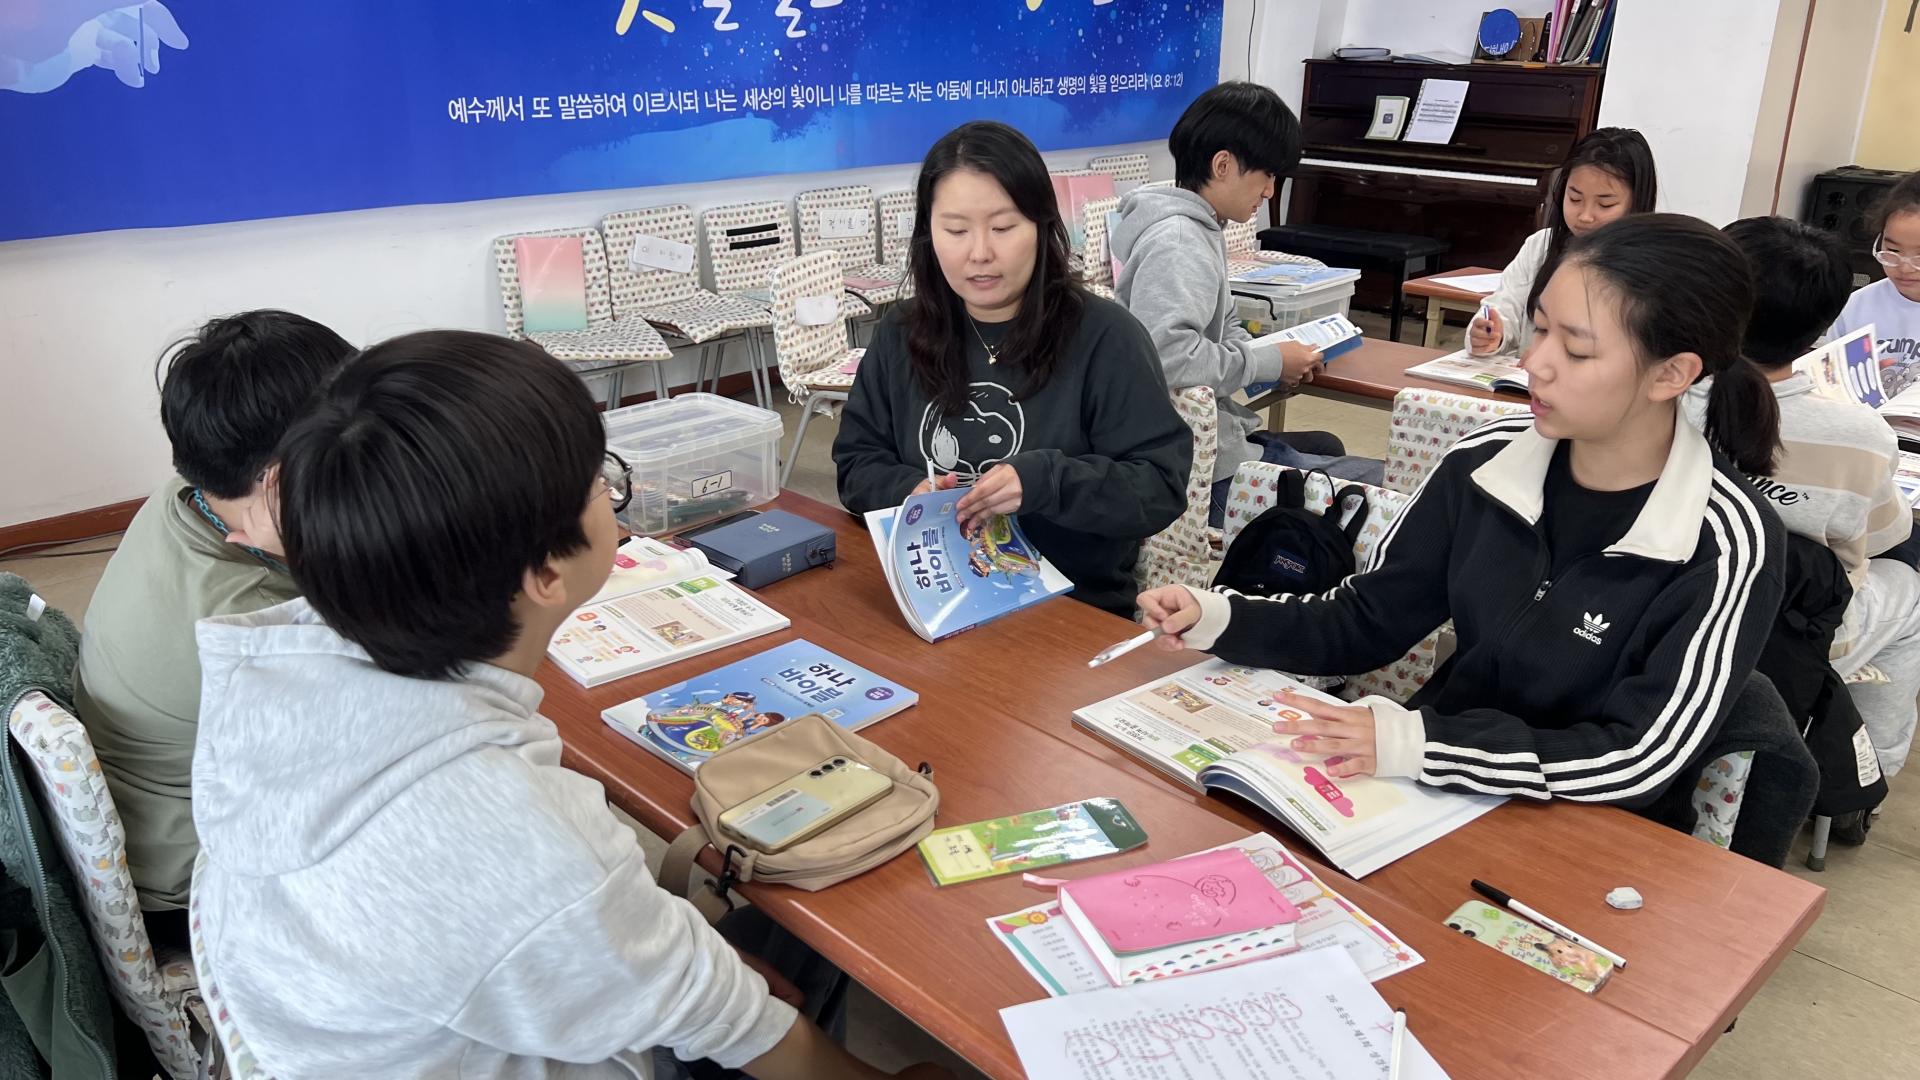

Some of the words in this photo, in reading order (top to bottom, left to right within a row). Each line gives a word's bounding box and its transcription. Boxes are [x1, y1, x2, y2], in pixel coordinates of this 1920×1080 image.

[448, 95, 525, 124] 예수께서
[531, 97, 553, 118] 또
[558, 92, 627, 120] 말씀하여
[632, 90, 699, 116] 이르시되
[705, 88, 738, 113] 나는
[743, 86, 786, 111] 세상의
[790, 84, 834, 108] 빛이니
[838, 84, 863, 105] 나를
[866, 82, 904, 104] 따르는
[908, 81, 933, 102] 자는
[937, 79, 972, 101] 어둠에
[975, 78, 1008, 99] 다니지
[1011, 77, 1054, 98] 아니하고
[1057, 75, 1087, 95] 생명의
[1089, 73, 1107, 94] 빛을
[1110, 72, 1148, 93] 얻으리라
[1150, 74, 1163, 90] (요
[1164, 72, 1184, 89] 8:12)
[702, 475, 723, 494] 6-1
[906, 541, 931, 589] 하나
[921, 528, 953, 593] 바이블
[1573, 627, 1602, 645] adidas
[777, 667, 844, 704] 바이블
[808, 662, 857, 688] 하나
